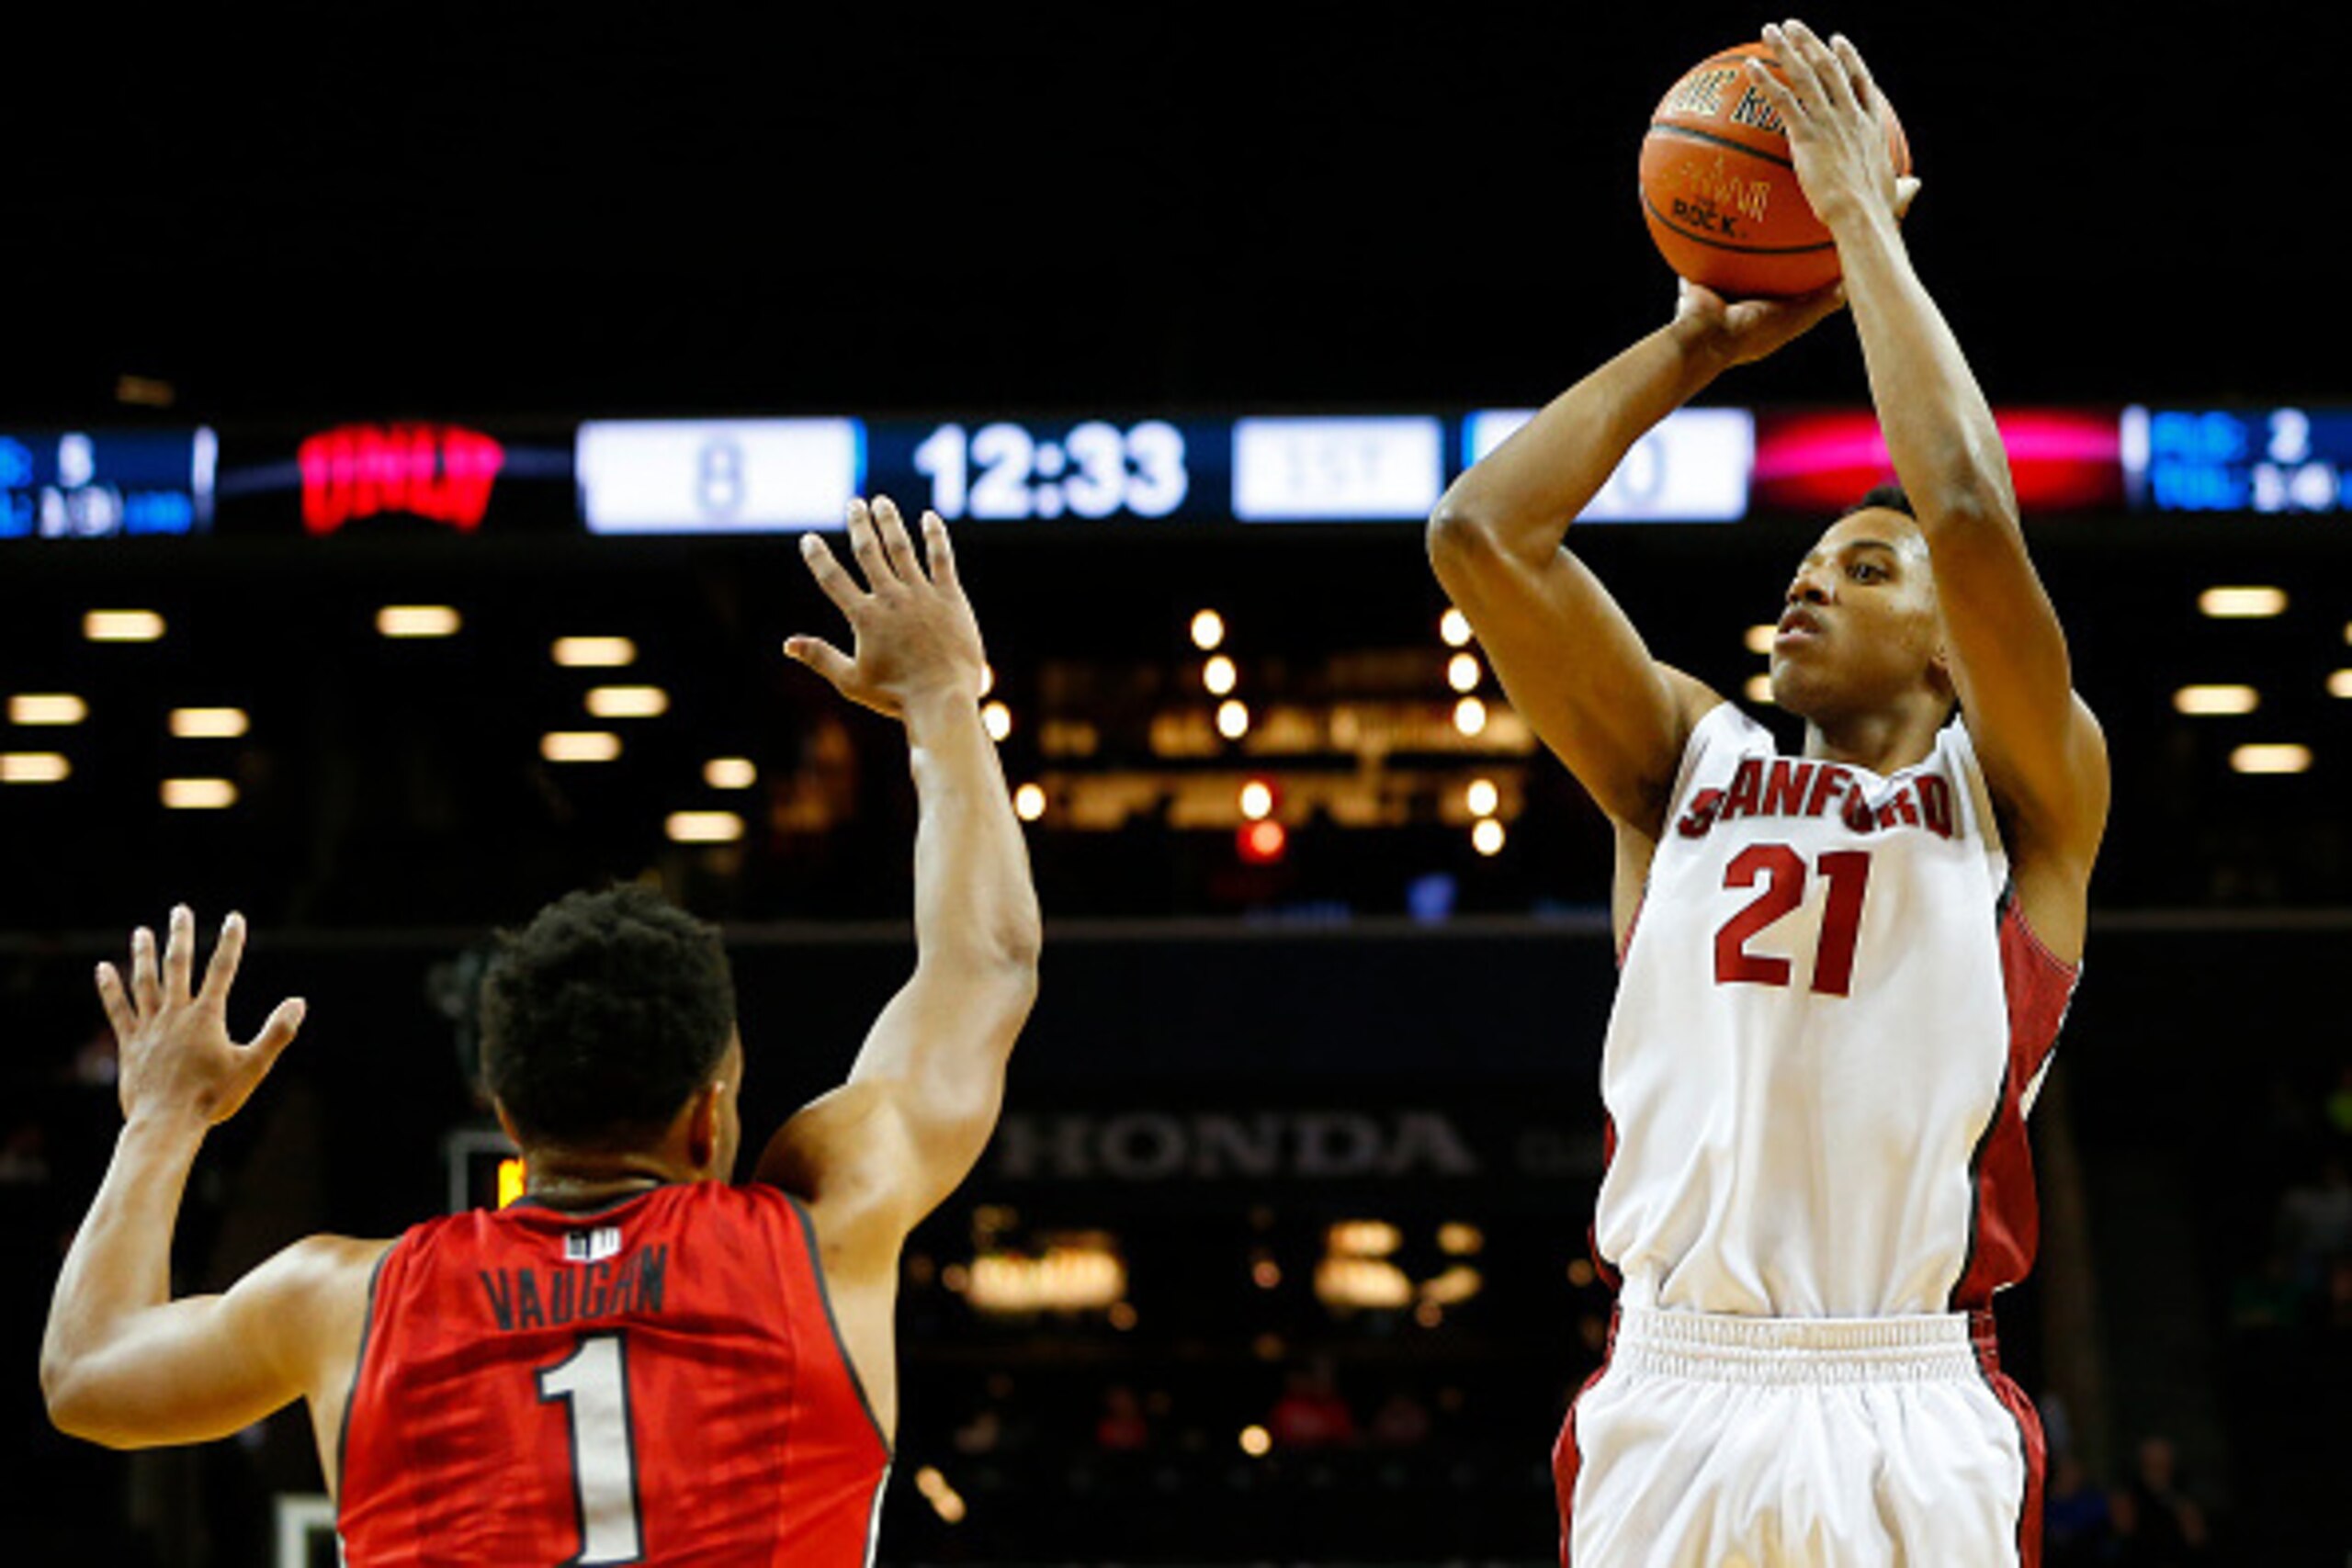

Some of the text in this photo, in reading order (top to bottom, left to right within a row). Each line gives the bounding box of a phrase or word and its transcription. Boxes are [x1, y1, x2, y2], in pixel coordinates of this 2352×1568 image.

[696, 432, 746, 519] 8
[914, 421, 1189, 519] 12:33
[1713, 842, 1872, 998] 21
[998, 1110, 1480, 1180] HONDA
[535, 1327, 647, 1568] 1
